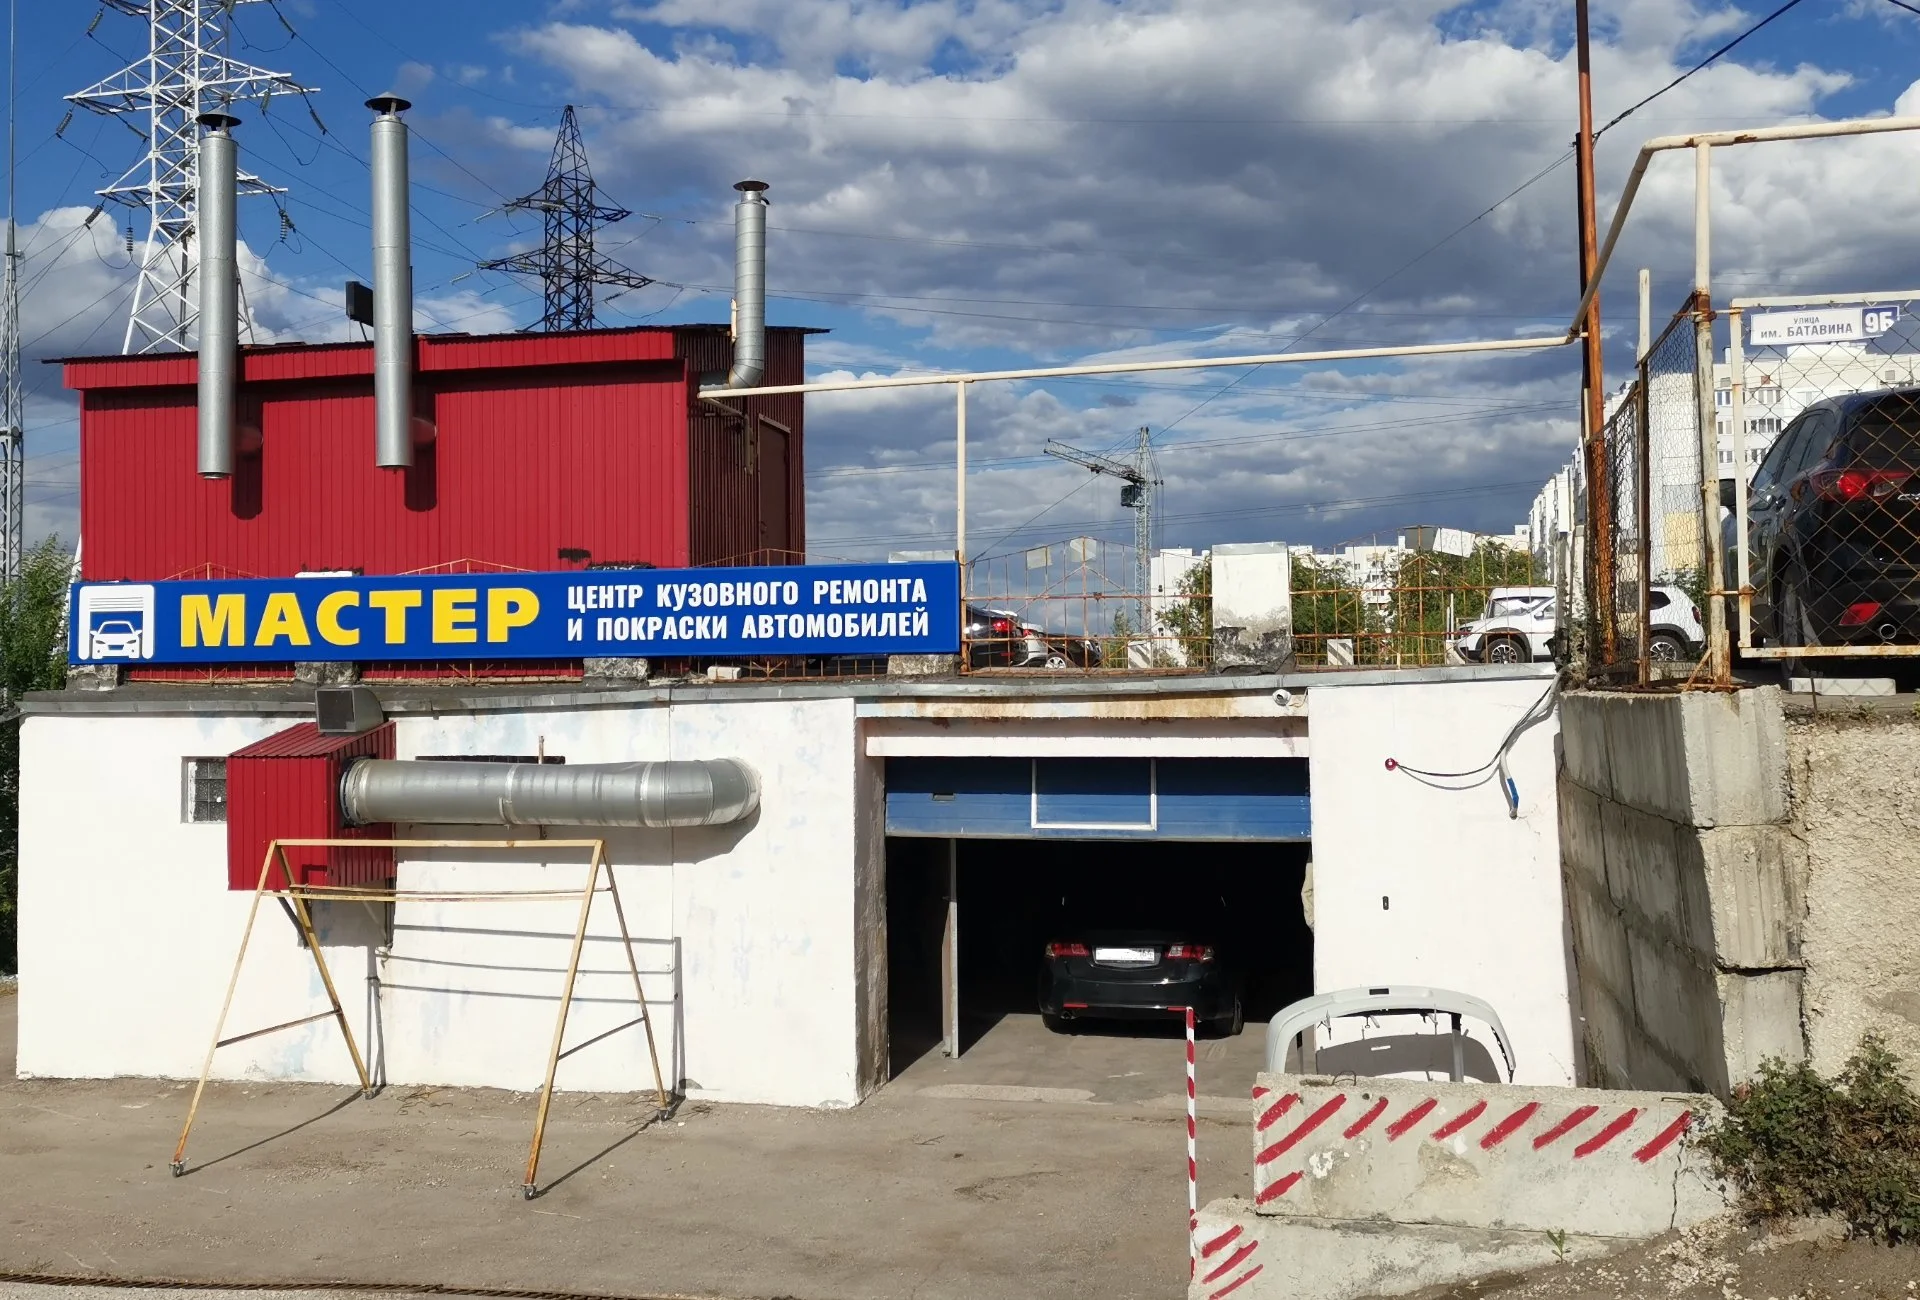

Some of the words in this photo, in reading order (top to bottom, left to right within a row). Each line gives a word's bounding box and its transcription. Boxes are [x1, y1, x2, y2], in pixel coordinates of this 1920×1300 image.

[1787, 323, 1853, 338] БАТАВИНА
[1793, 316, 1820, 325] УЛИЦА
[567, 584, 644, 614] ЦЕНТР
[656, 580, 799, 612] КУЗОВНОГО
[813, 578, 927, 605] РЕМОНТА
[180, 587, 540, 648] МАСТЕР
[567, 618, 583, 642] И
[597, 615, 727, 641] ПОКРАСКИ
[741, 606, 929, 639] АВТОМОБИЛЕЙ
